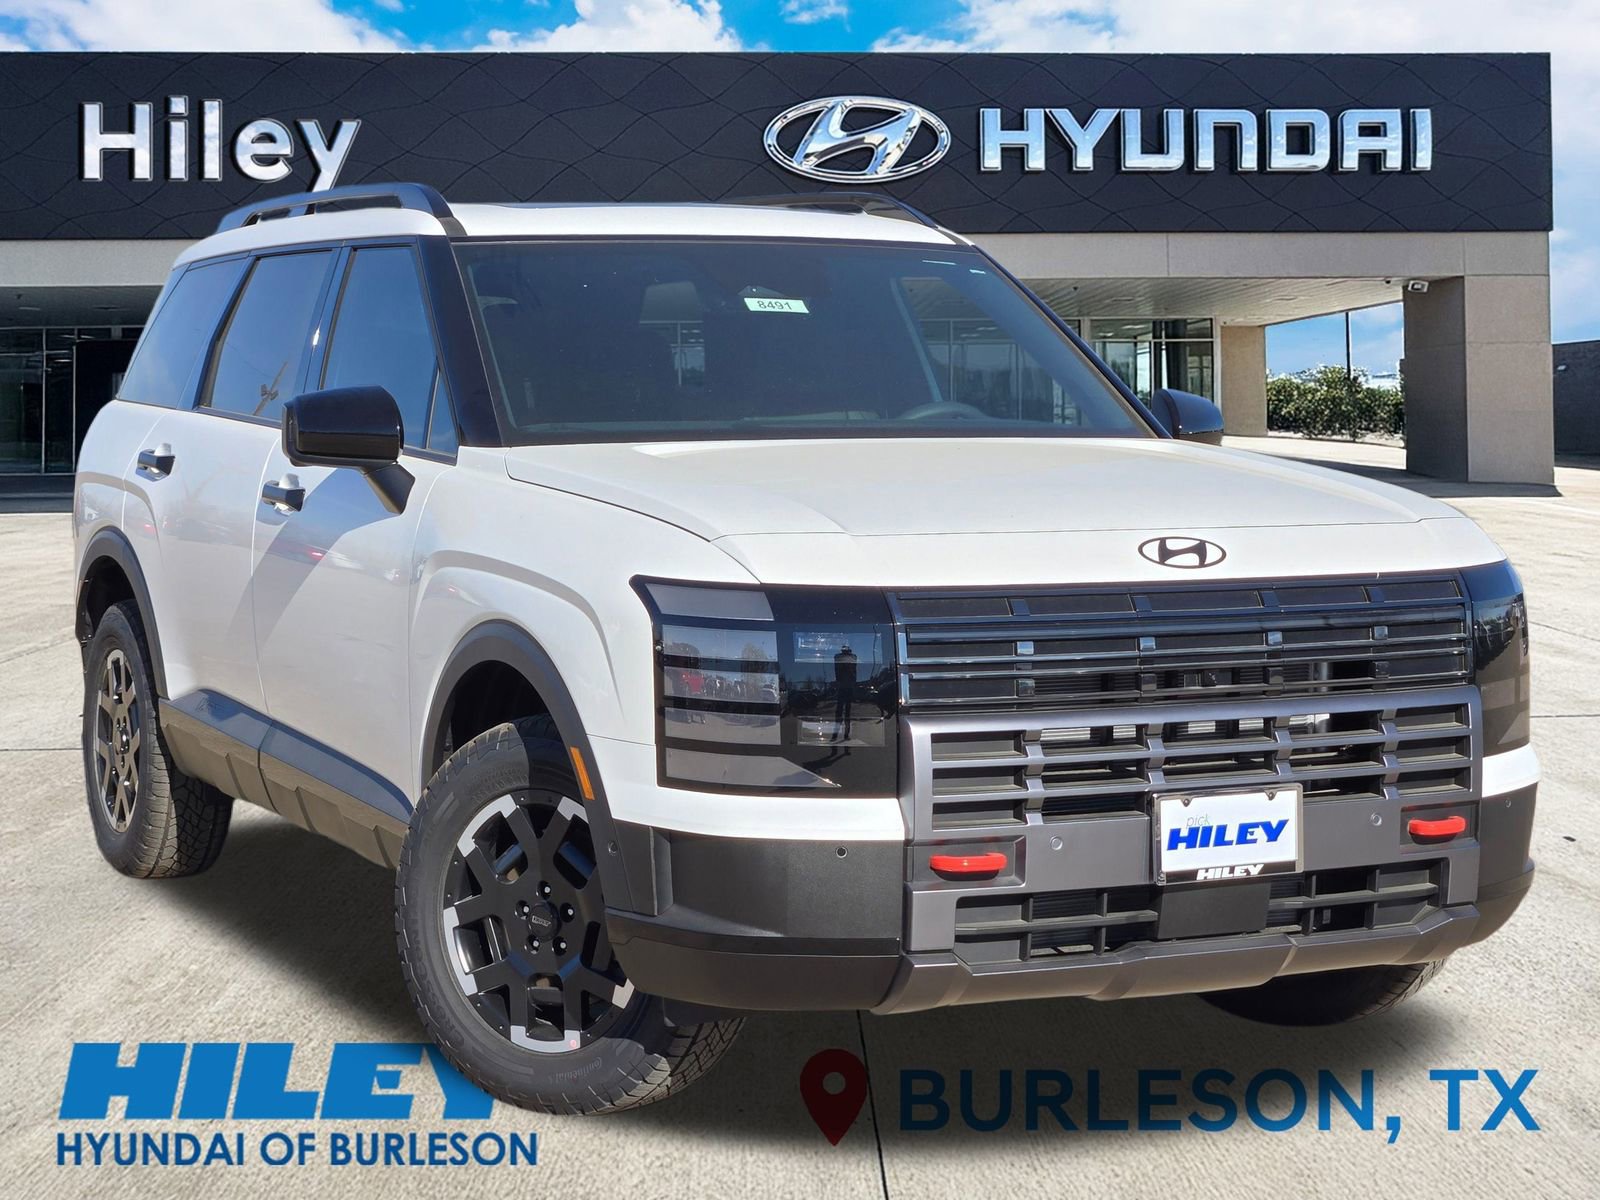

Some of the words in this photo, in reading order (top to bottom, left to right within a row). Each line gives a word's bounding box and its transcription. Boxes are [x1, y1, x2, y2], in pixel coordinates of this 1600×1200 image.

[81, 95, 361, 193] Hiley
[978, 107, 1433, 171] HYUNDAI
[757, 300, 793, 311] 8491
[1167, 818, 1289, 851] HILEY
[1196, 863, 1265, 881] HILEY
